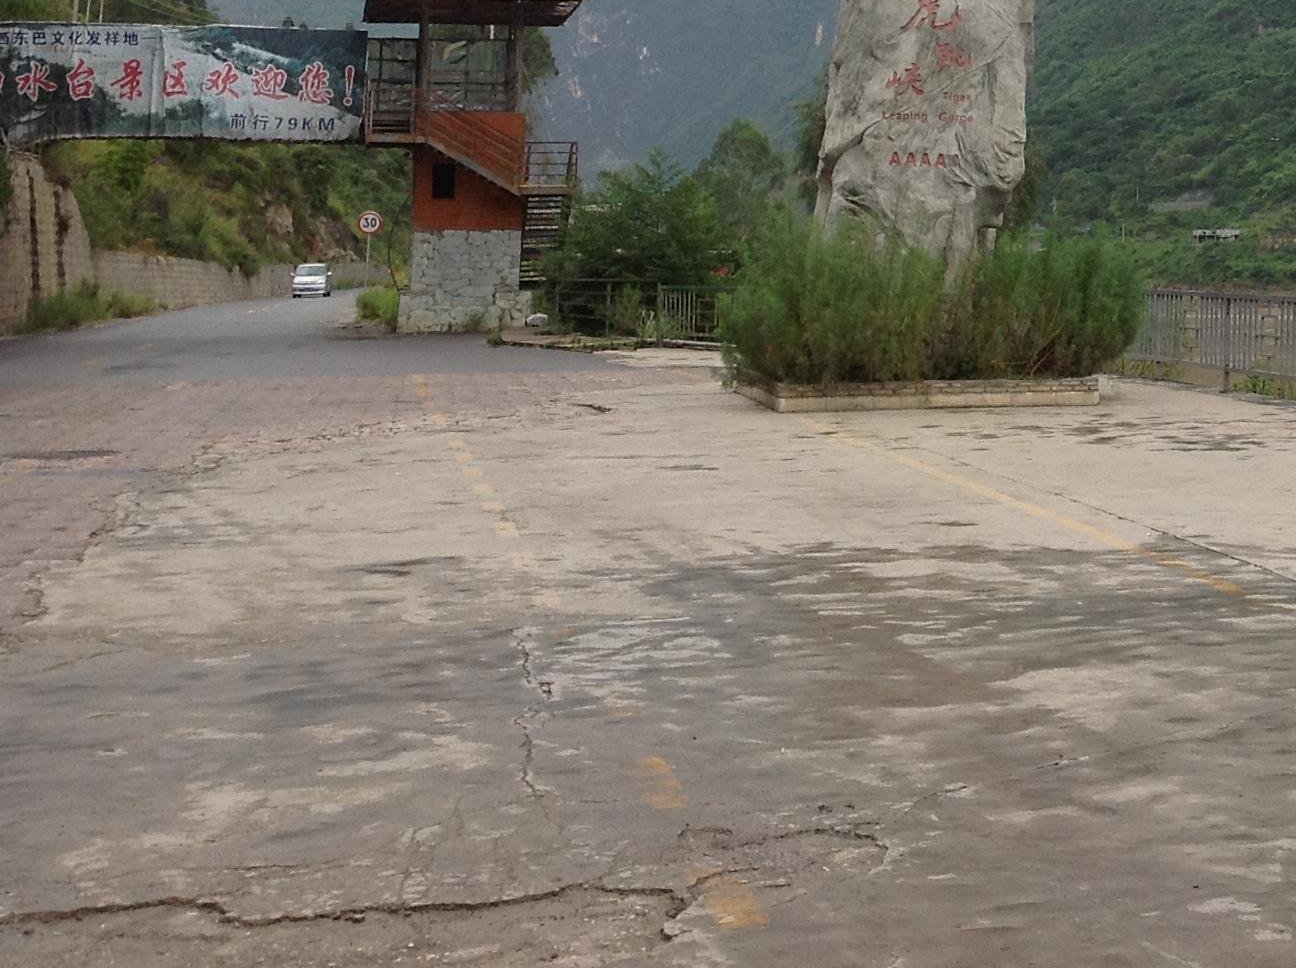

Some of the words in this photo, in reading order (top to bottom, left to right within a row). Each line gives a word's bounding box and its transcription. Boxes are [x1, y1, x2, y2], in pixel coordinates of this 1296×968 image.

[0, 59, 354, 106] 水台景区欢迎您!
[882, 111, 928, 124] Leaping
[938, 112, 975, 124] Gorge
[362, 217, 377, 228] 30
